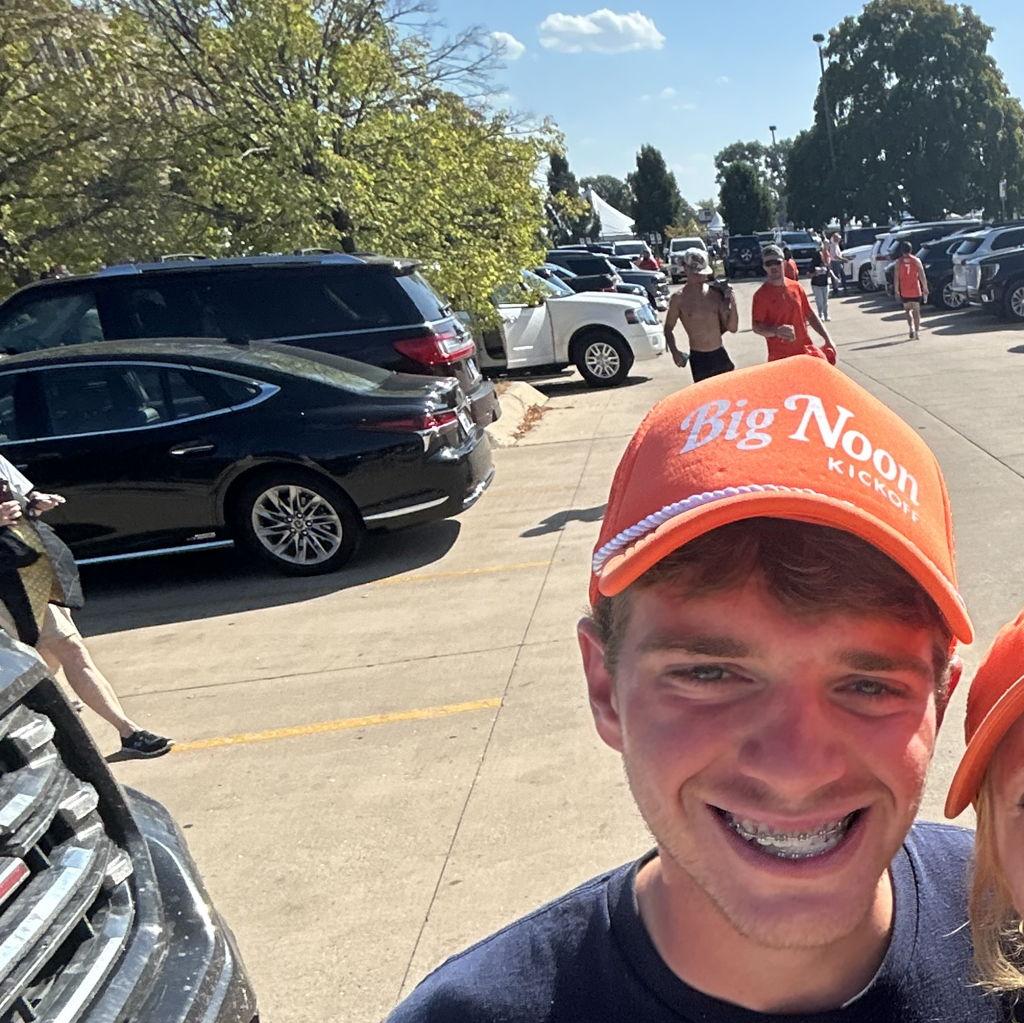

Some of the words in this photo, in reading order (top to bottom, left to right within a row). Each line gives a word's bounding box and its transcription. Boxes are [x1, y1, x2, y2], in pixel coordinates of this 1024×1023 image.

[679, 398, 779, 455] Big
[784, 394, 920, 506] Noon
[827, 456, 921, 524] KICKOFF
